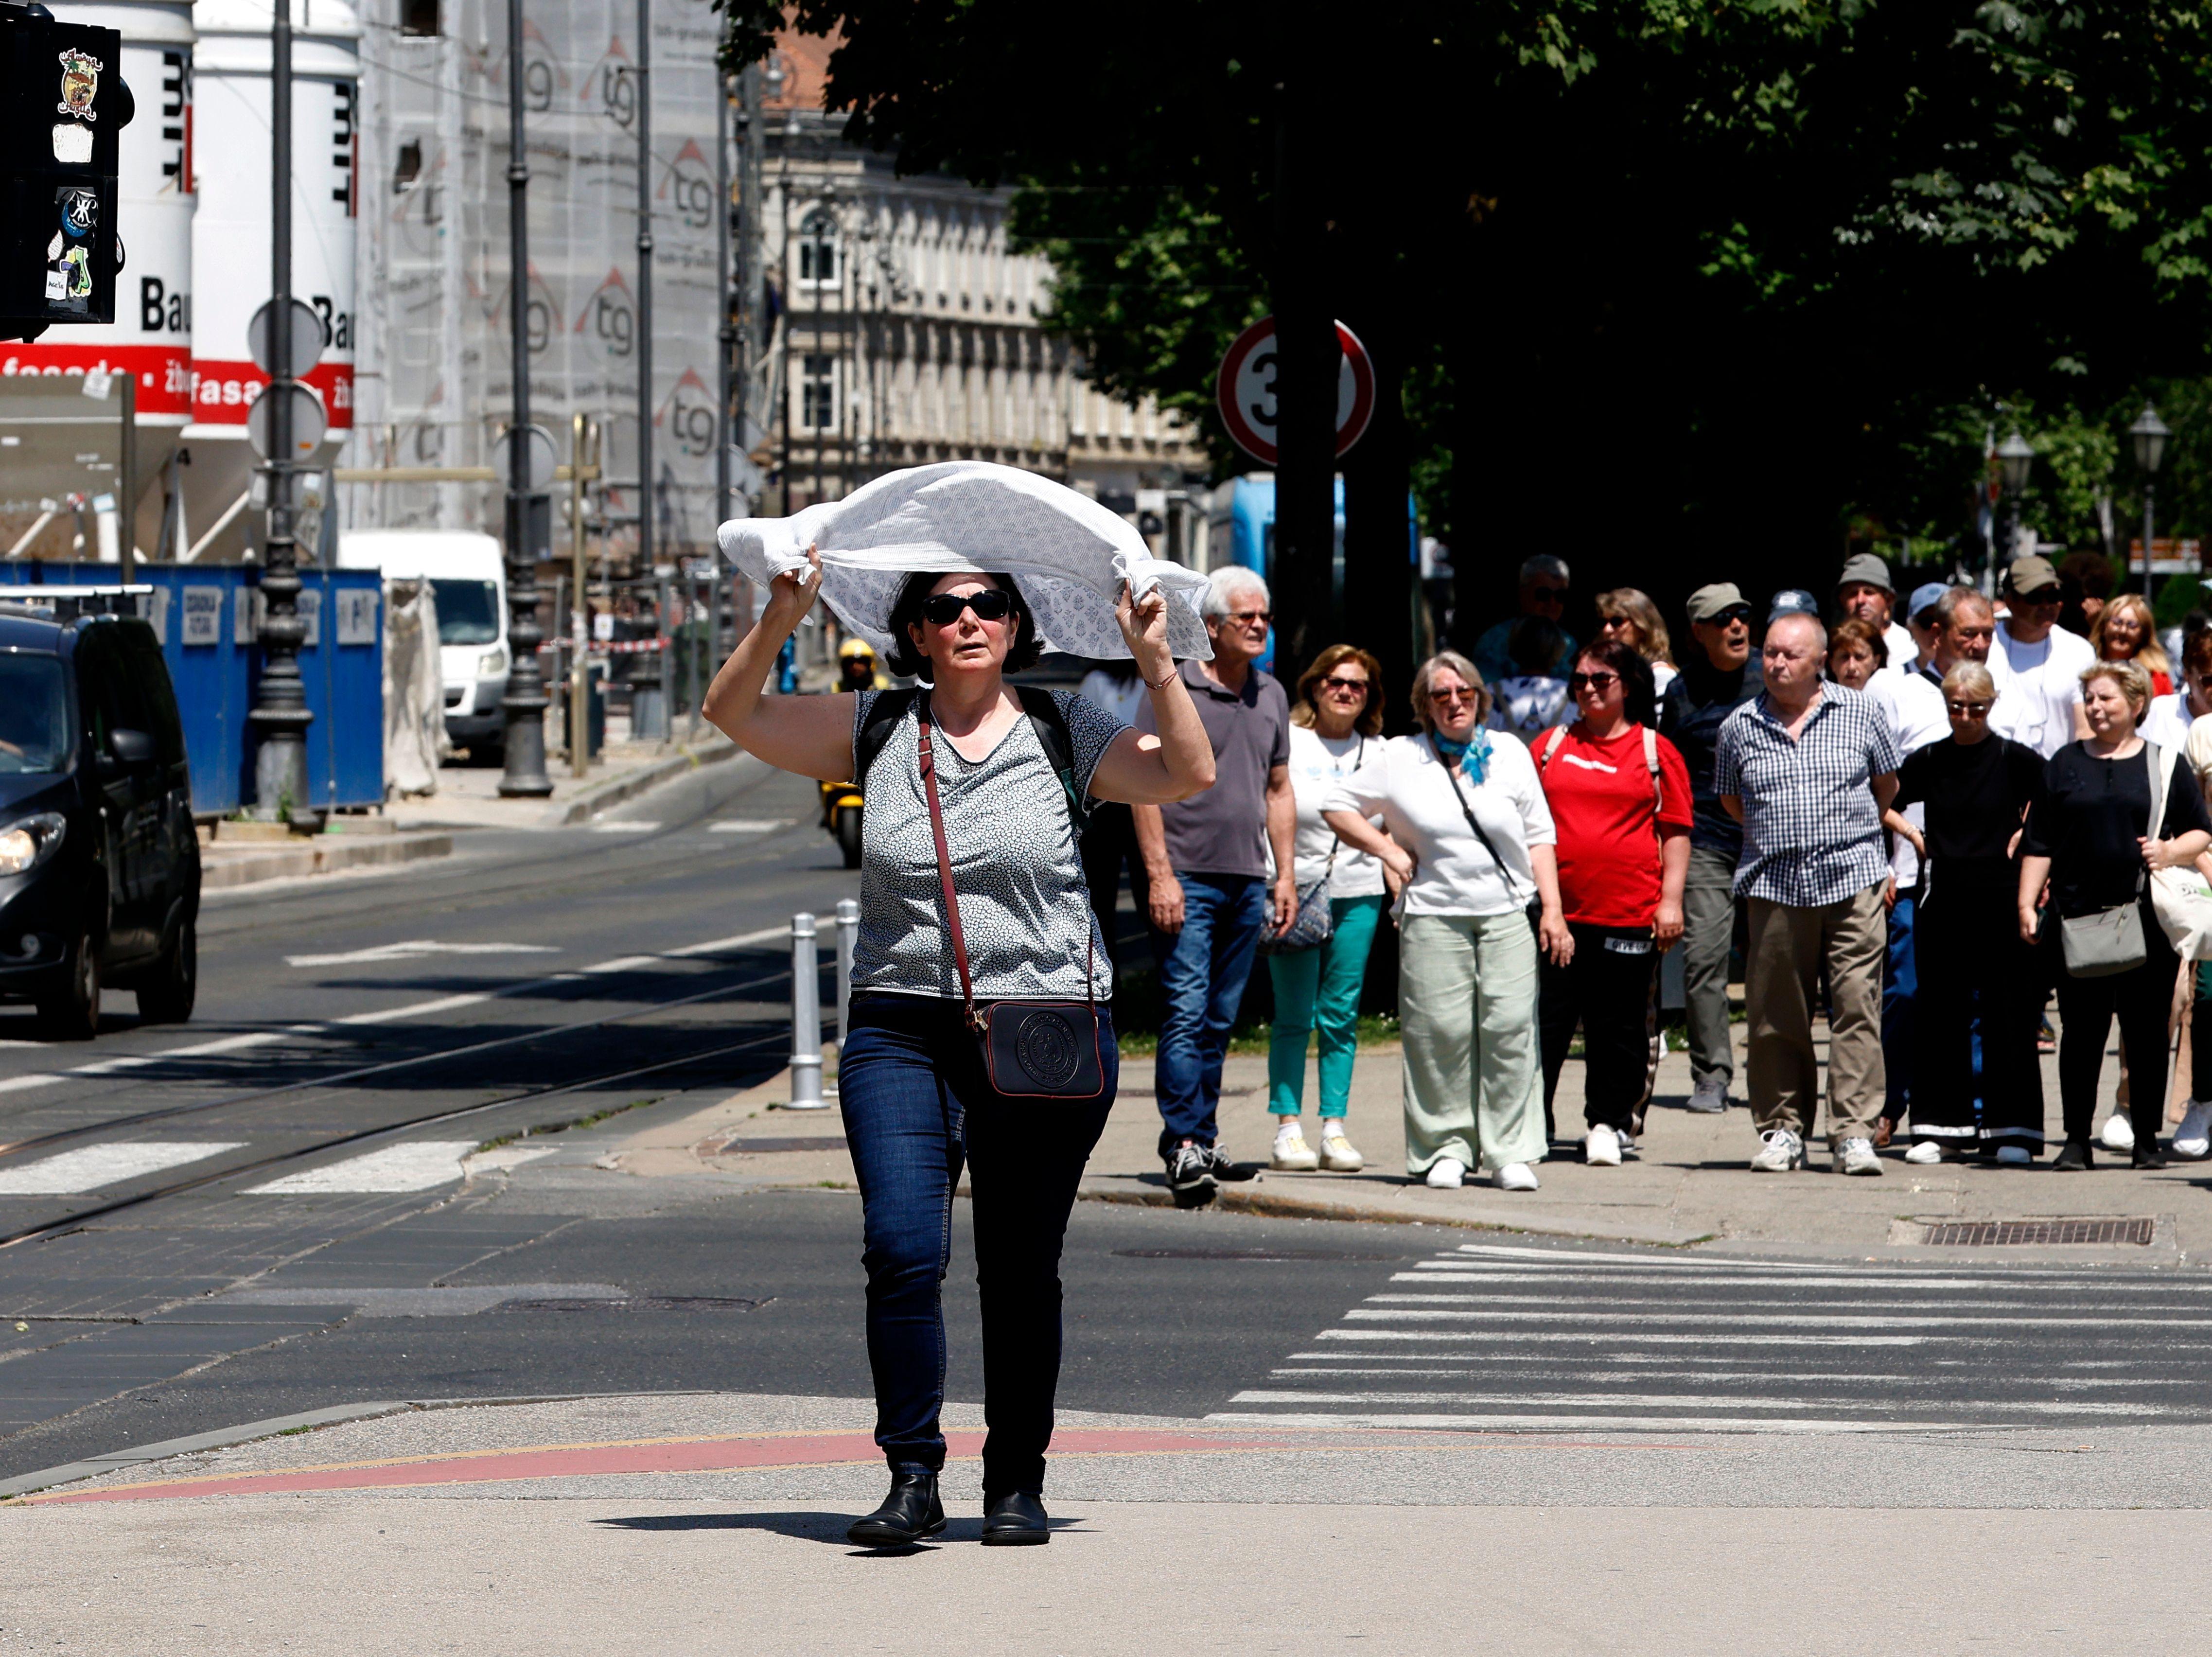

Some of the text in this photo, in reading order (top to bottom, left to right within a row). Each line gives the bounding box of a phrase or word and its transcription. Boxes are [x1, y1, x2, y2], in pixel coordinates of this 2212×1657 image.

[674, 172, 712, 228] tg
[598, 296, 632, 356] tg
[672, 396, 714, 457] tg
